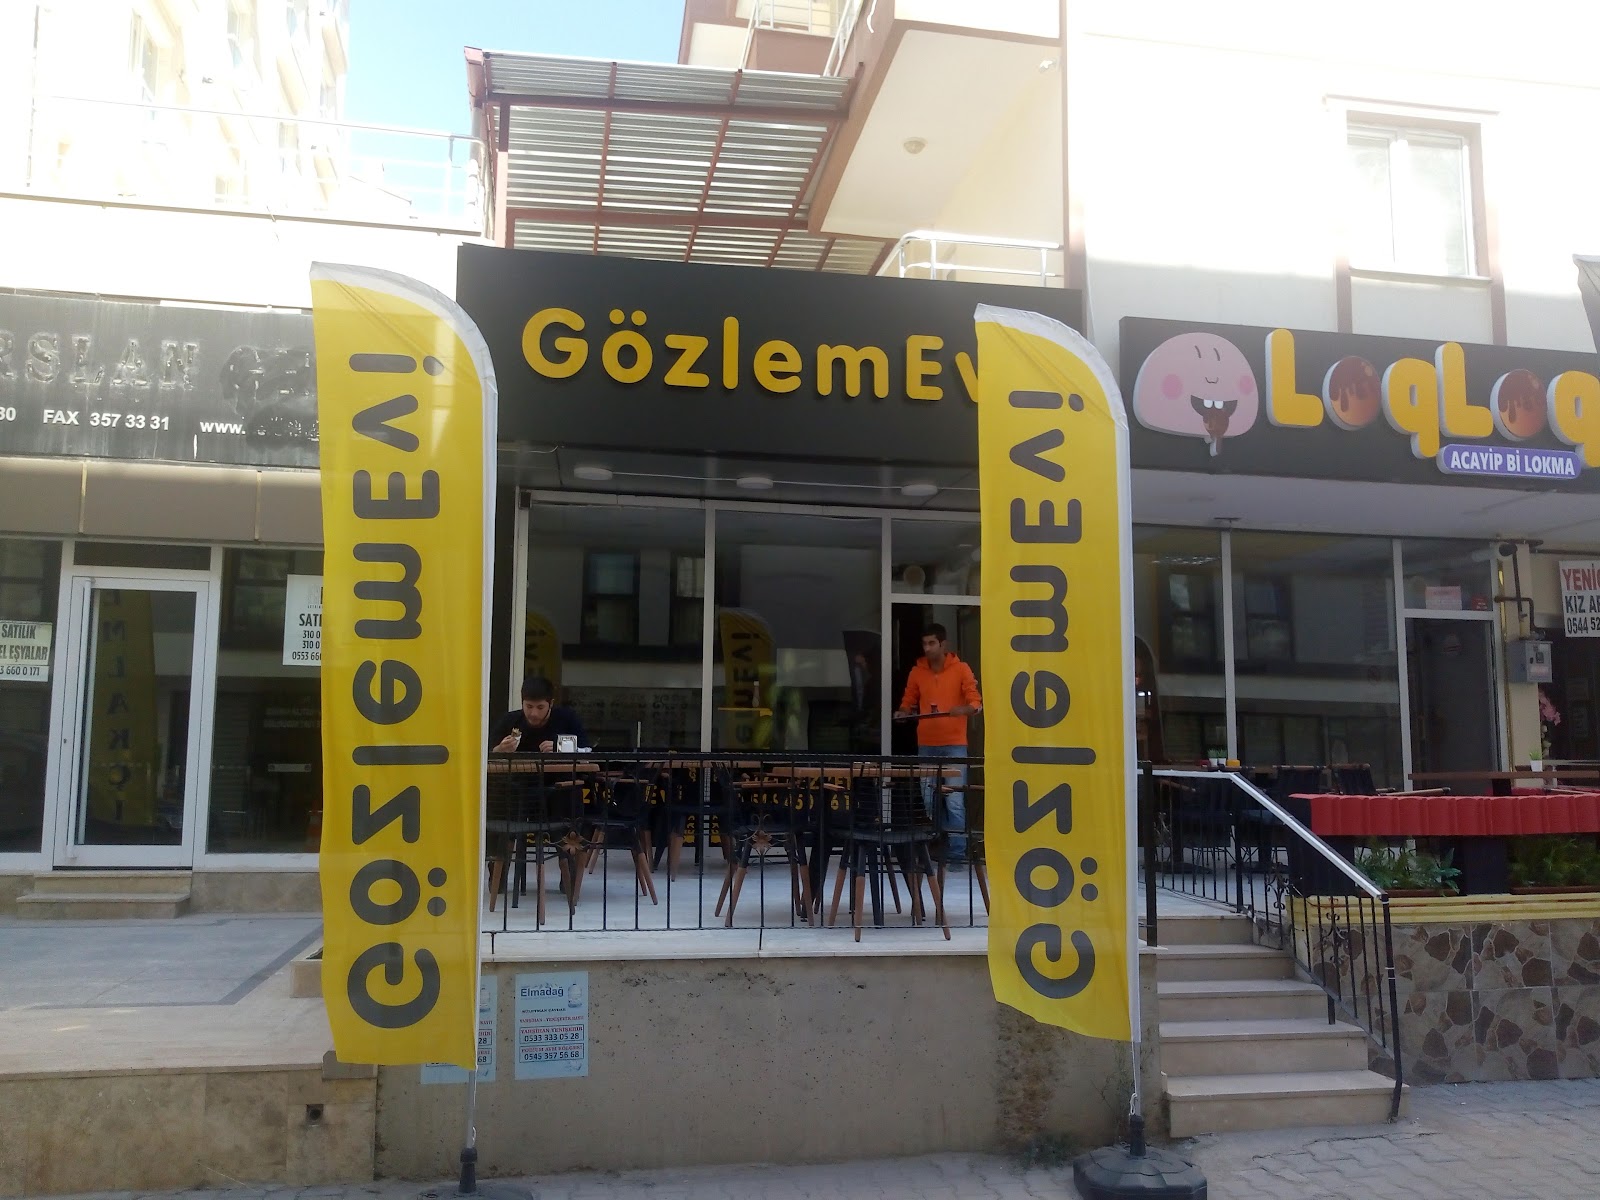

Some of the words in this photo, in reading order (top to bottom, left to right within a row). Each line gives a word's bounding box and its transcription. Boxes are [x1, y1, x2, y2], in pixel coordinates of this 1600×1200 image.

[43, 409, 79, 426] FAX
[90, 412, 122, 428] 357
[125, 415, 146, 430] 33
[150, 416, 170, 431] 31
[1451, 448, 1503, 471] ACAYİP
[1506, 450, 1521, 473] Bİ
[1524, 455, 1575, 476] LOKMA
[1567, 617, 1589, 635] 0544
[1, 624, 37, 640] SATILIK
[302, 630, 315, 639] 310
[302, 640, 314, 649] 310
[9, 645, 48, 663] EŞYALAR
[292, 651, 309, 661] 0553
[6, 666, 21, 676] 660
[22, 667, 28, 676] 0
[30, 667, 40, 676] 171
[520, 987, 564, 998] Elmadağ
[570, 1032, 580, 1040] 28
